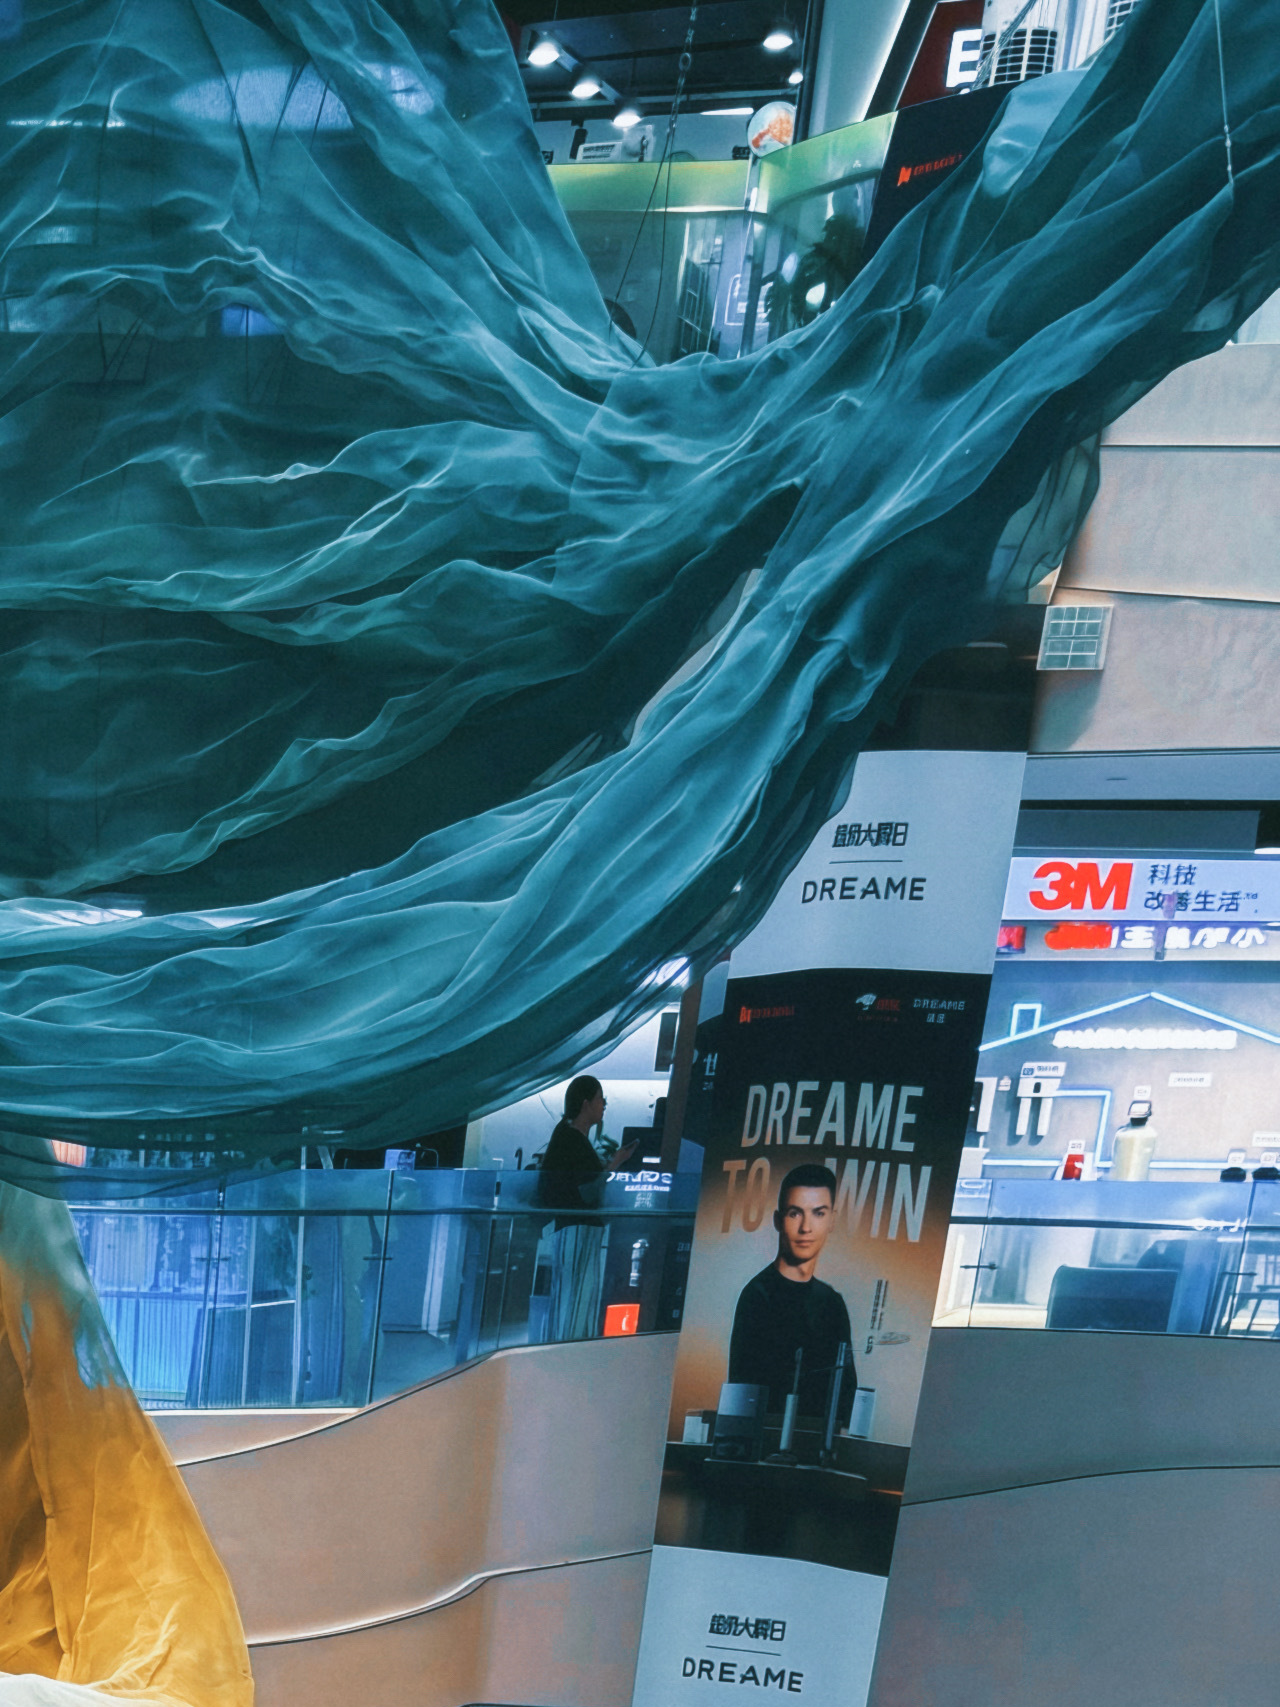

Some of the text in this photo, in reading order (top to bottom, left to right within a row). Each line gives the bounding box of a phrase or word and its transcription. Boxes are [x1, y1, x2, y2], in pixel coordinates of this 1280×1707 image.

[800, 875, 928, 906] DREAME
[1028, 861, 1134, 911] 3M
[1148, 863, 1198, 886] 科技
[740, 1081, 925, 1152] DREAME
[720, 1156, 933, 1243] TO WIN
[682, 1656, 804, 1694] DREAME
